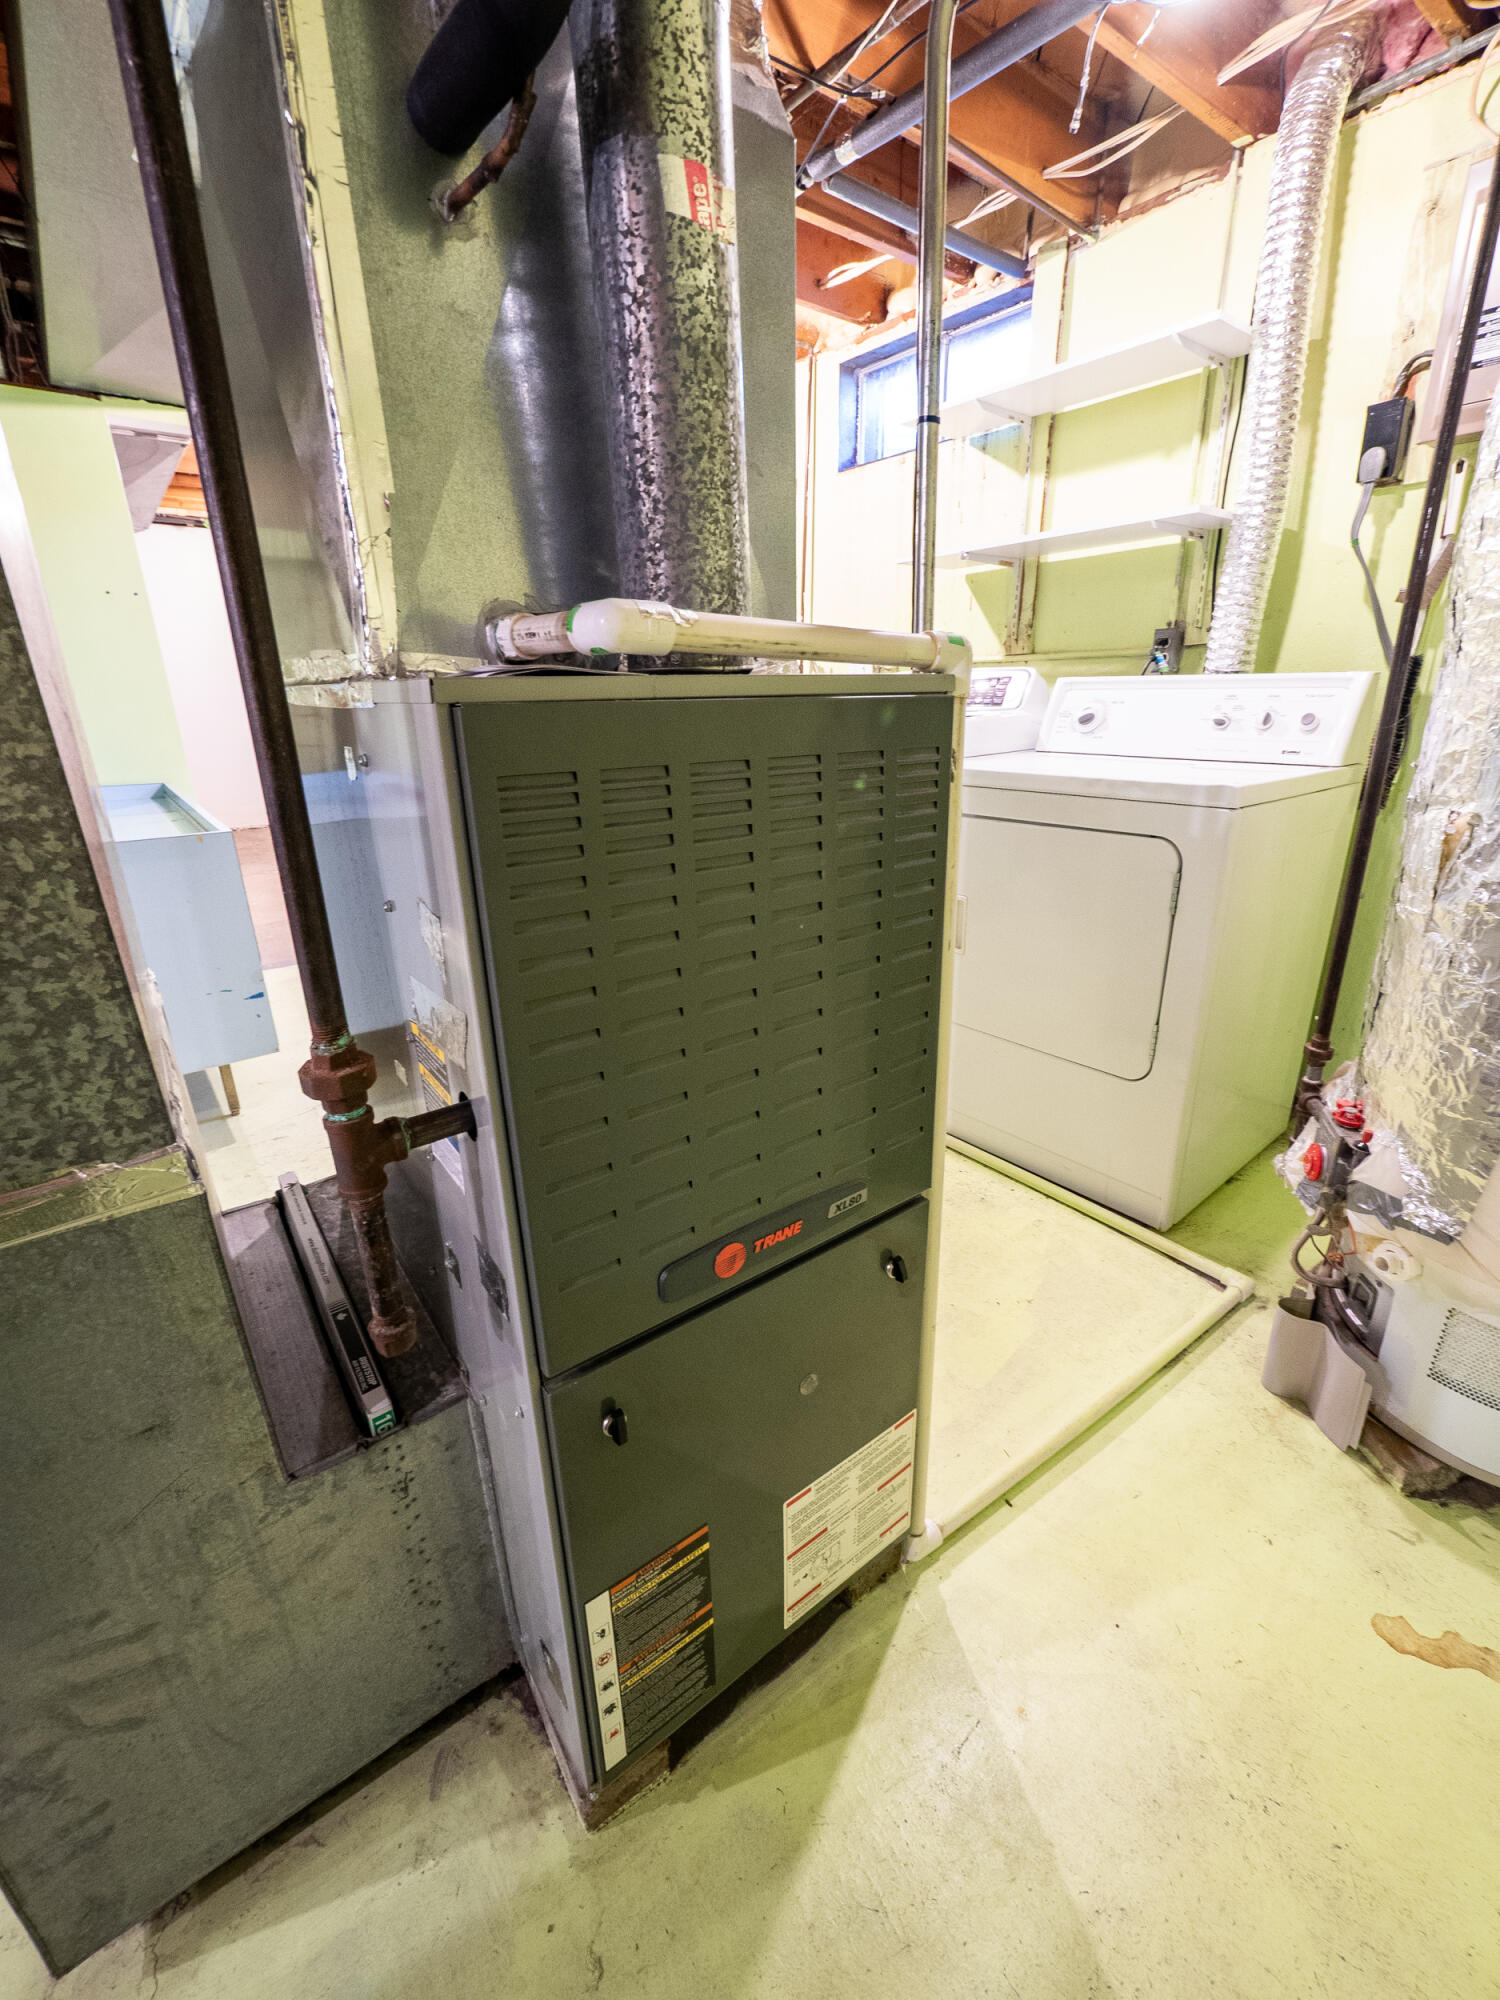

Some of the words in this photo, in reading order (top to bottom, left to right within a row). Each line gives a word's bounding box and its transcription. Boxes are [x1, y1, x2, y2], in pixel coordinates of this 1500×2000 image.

[833, 1193, 863, 1215] XL80
[754, 1219, 803, 1254] TRANE
[375, 1413, 394, 1434] 16
